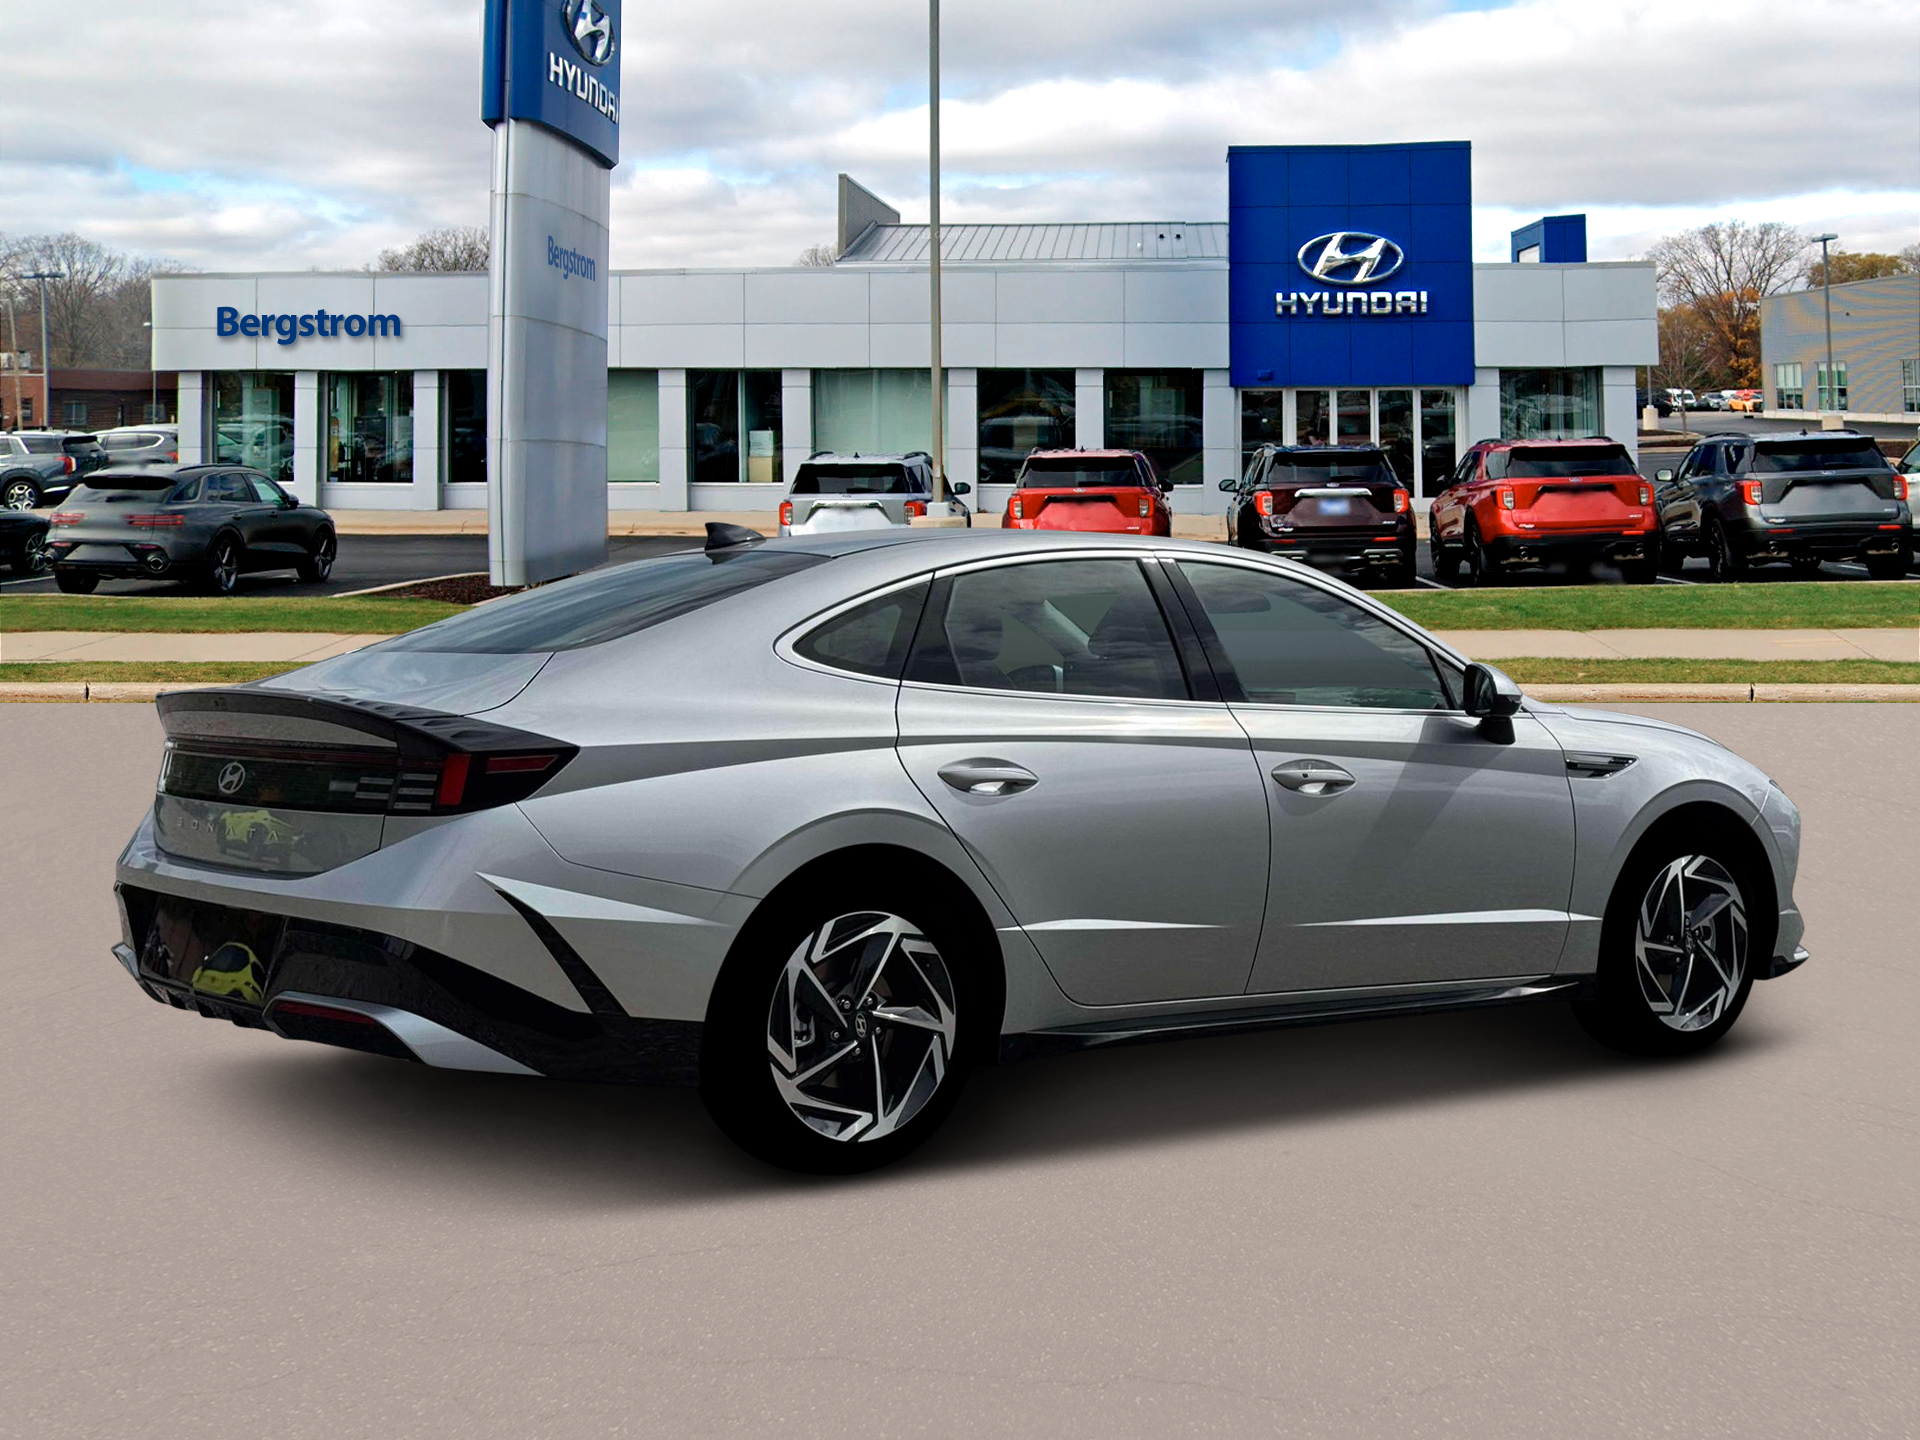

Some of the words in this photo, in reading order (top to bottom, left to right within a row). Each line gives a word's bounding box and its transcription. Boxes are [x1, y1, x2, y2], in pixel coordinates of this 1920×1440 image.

[549, 52, 619, 124] HYUNDAI
[547, 235, 596, 282] Bergstrom
[1275, 291, 1428, 315] HYUNDAI
[216, 306, 402, 346] Bergstrom
[177, 817, 279, 841] SONATA
